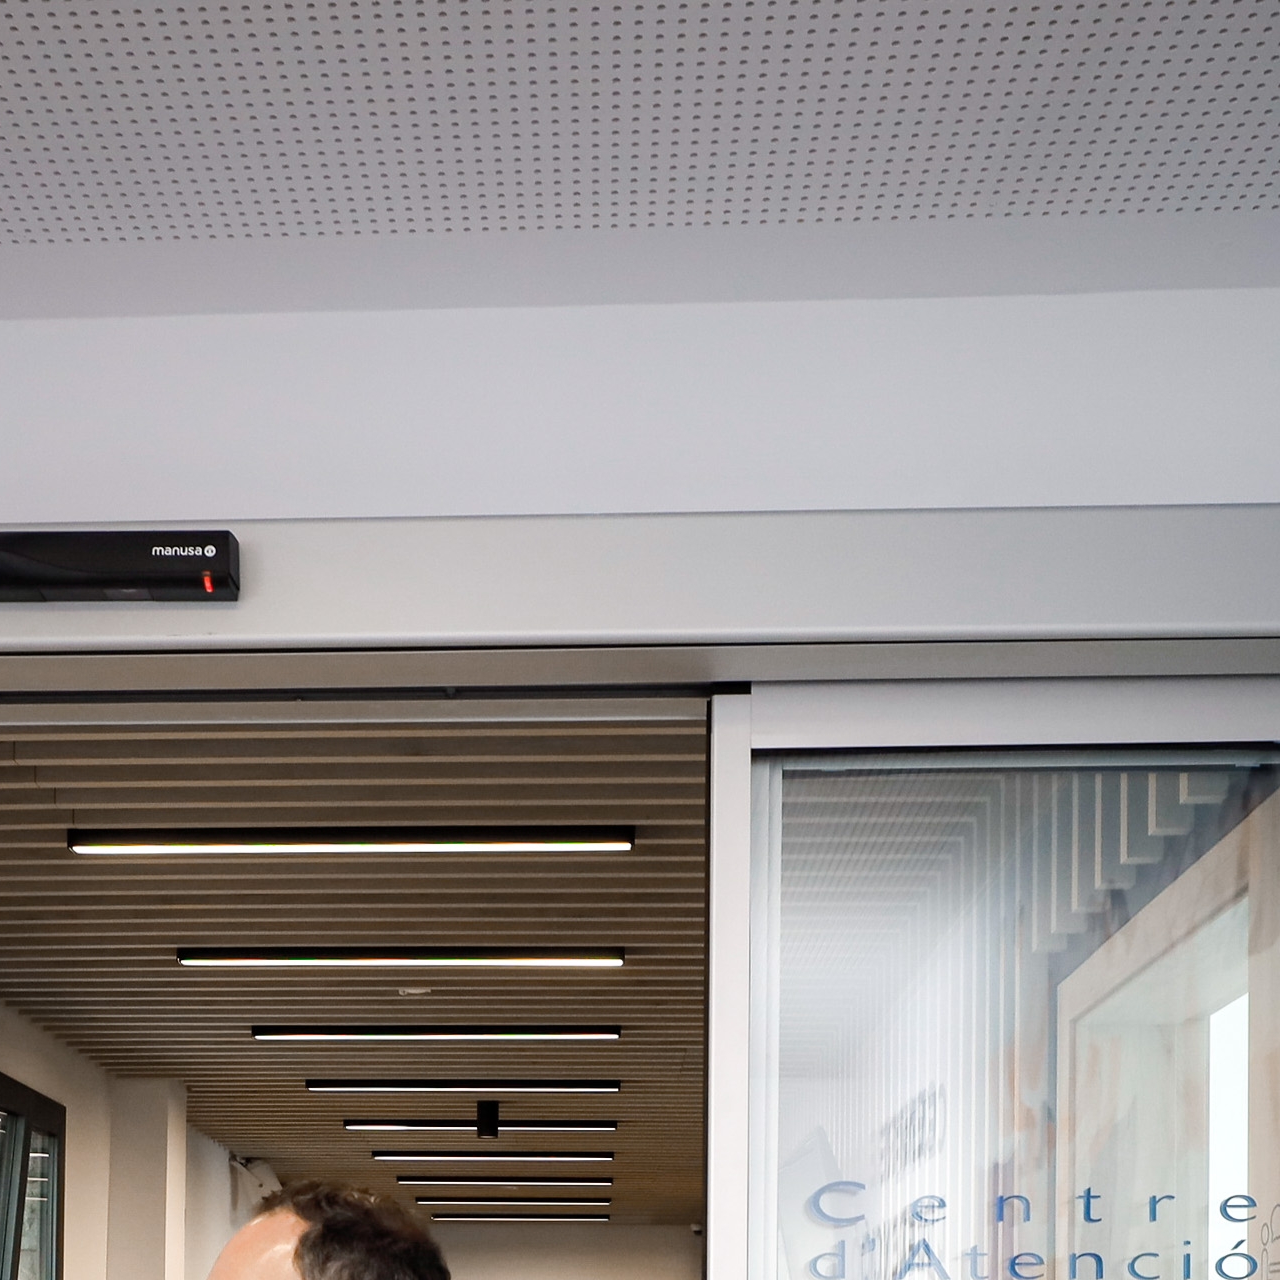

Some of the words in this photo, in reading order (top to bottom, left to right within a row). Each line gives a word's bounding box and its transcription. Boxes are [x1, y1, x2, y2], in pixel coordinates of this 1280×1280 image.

[151, 546, 203, 556] manusa
[809, 1180, 1257, 1225] Centre
[809, 1237, 1258, 1280] d'Atenció
